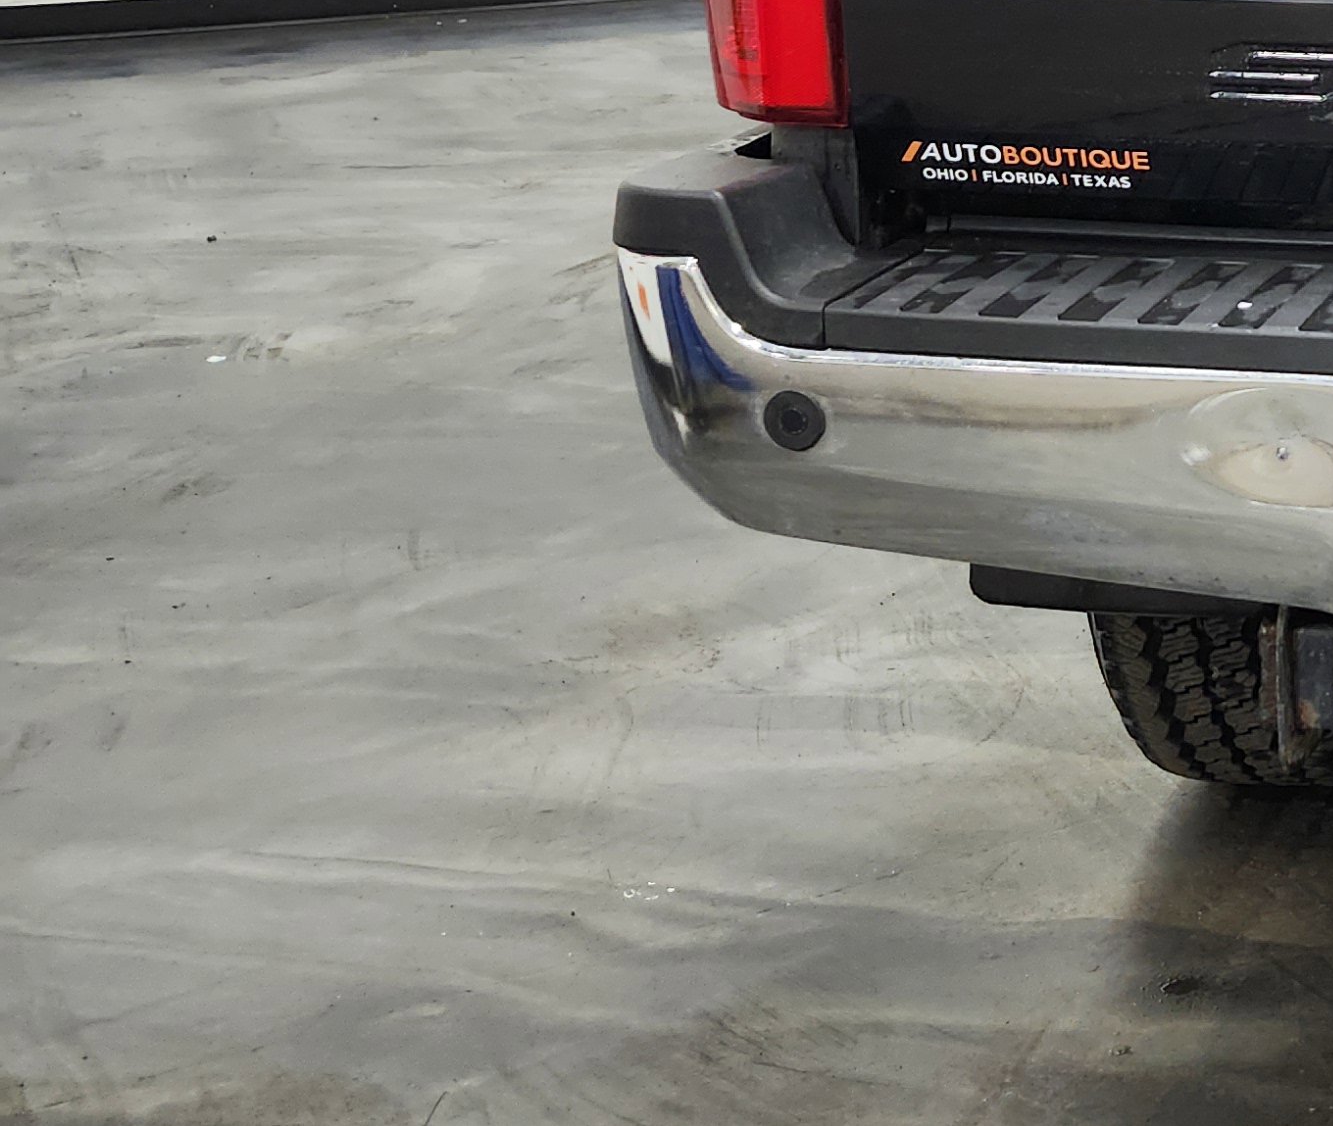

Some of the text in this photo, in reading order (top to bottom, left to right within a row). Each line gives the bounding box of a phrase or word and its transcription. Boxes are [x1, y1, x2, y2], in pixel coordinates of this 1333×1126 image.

[919, 141, 1151, 171] AUTOBOUTIQUE
[922, 166, 969, 182] OHIO
[981, 169, 1057, 186] FLORIDA
[1070, 173, 1132, 189] TEXAS
